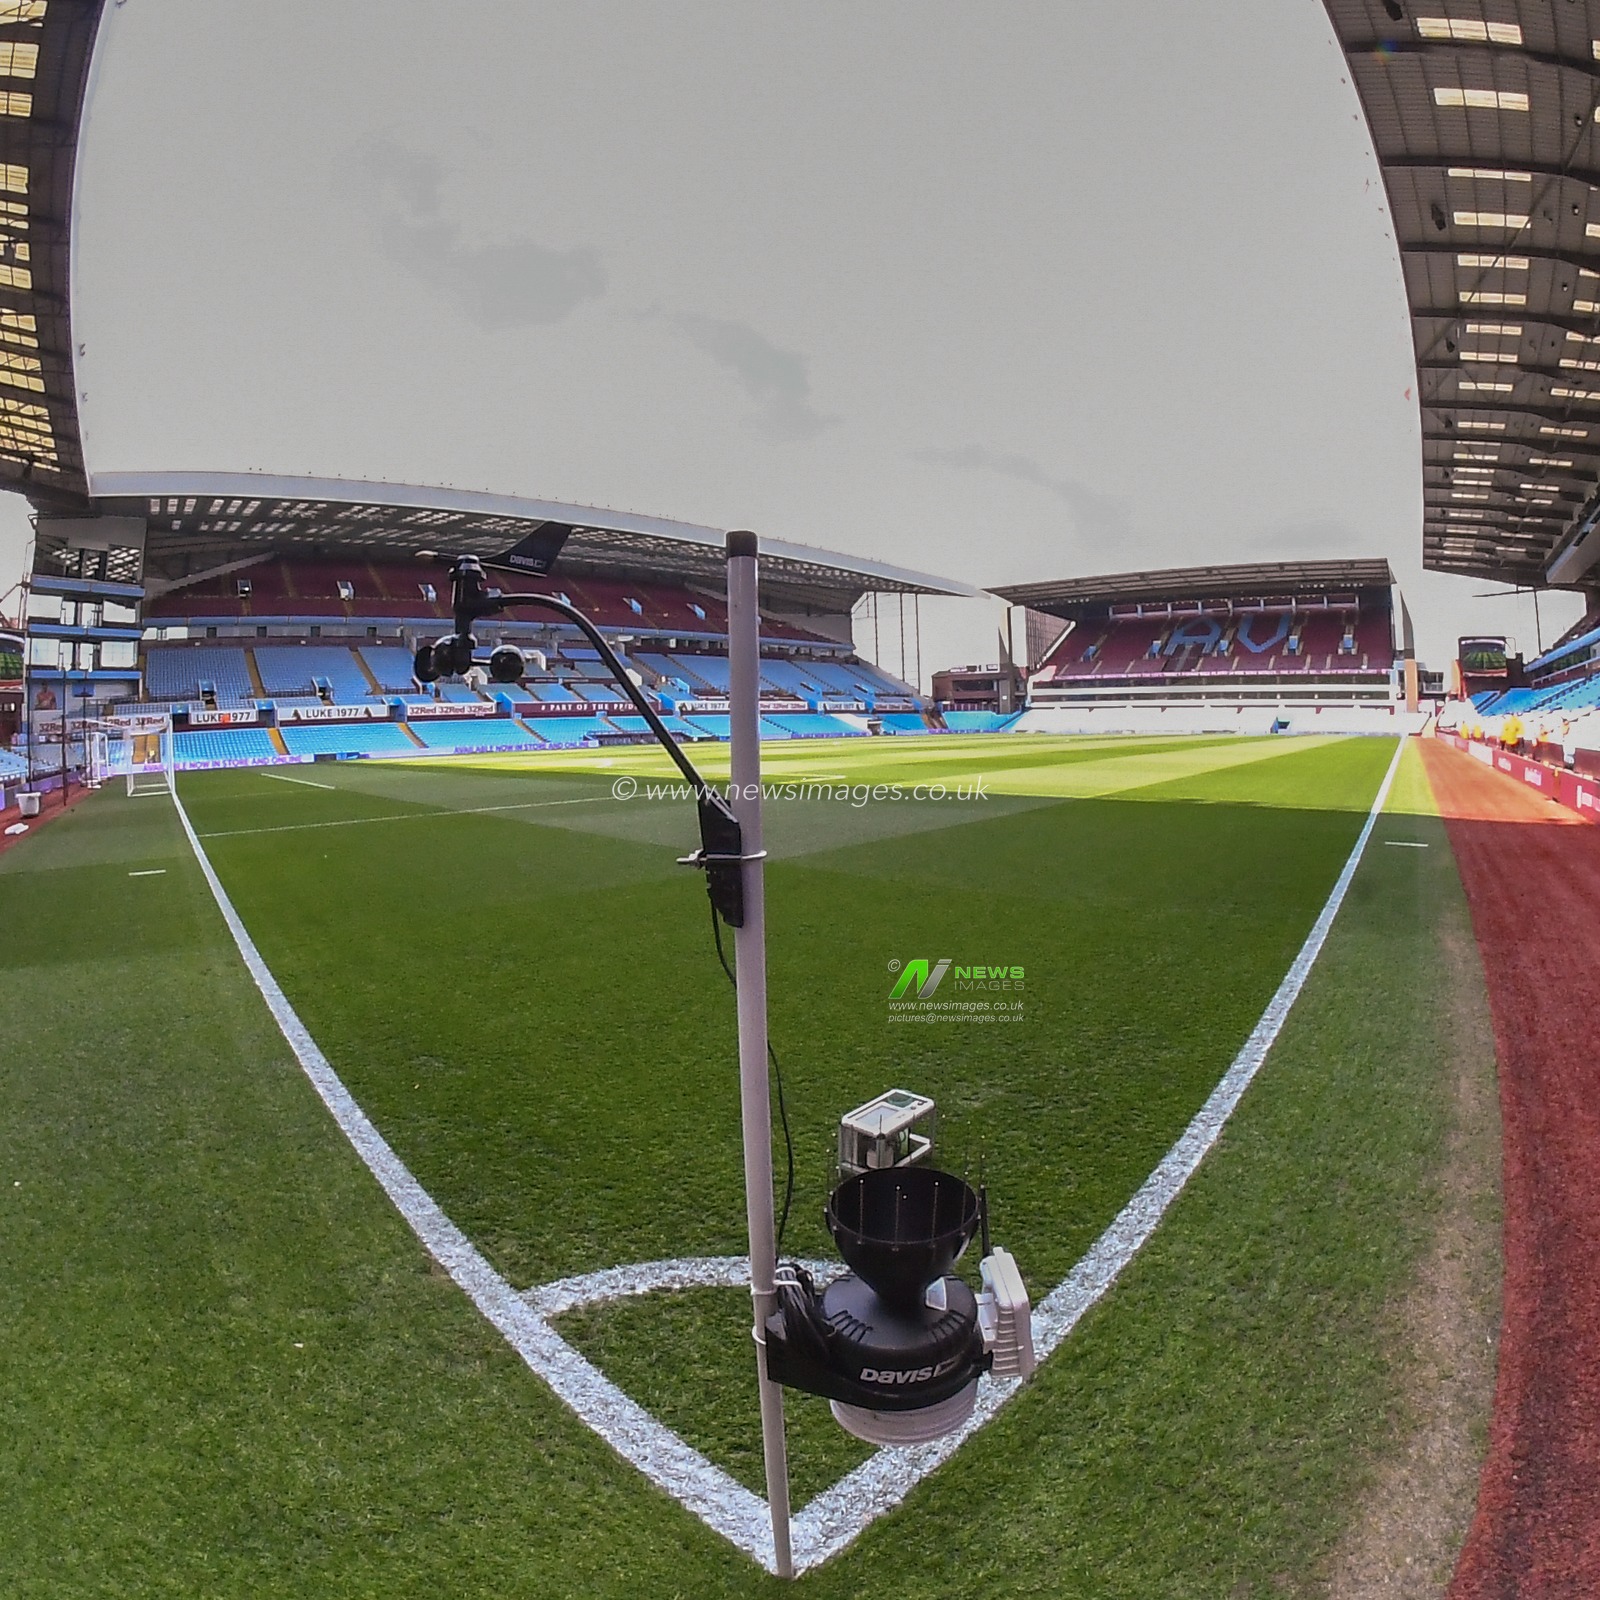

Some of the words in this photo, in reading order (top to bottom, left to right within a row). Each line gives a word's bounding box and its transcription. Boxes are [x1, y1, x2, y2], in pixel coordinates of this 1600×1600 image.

[306, 709, 333, 718] LUKE
[336, 708, 359, 717] 1977
[409, 706, 436, 714] 32Red
[467, 705, 493, 713] 32Red
[196, 713, 223, 723] LUKE
[39, 723, 65, 732] 32Re
